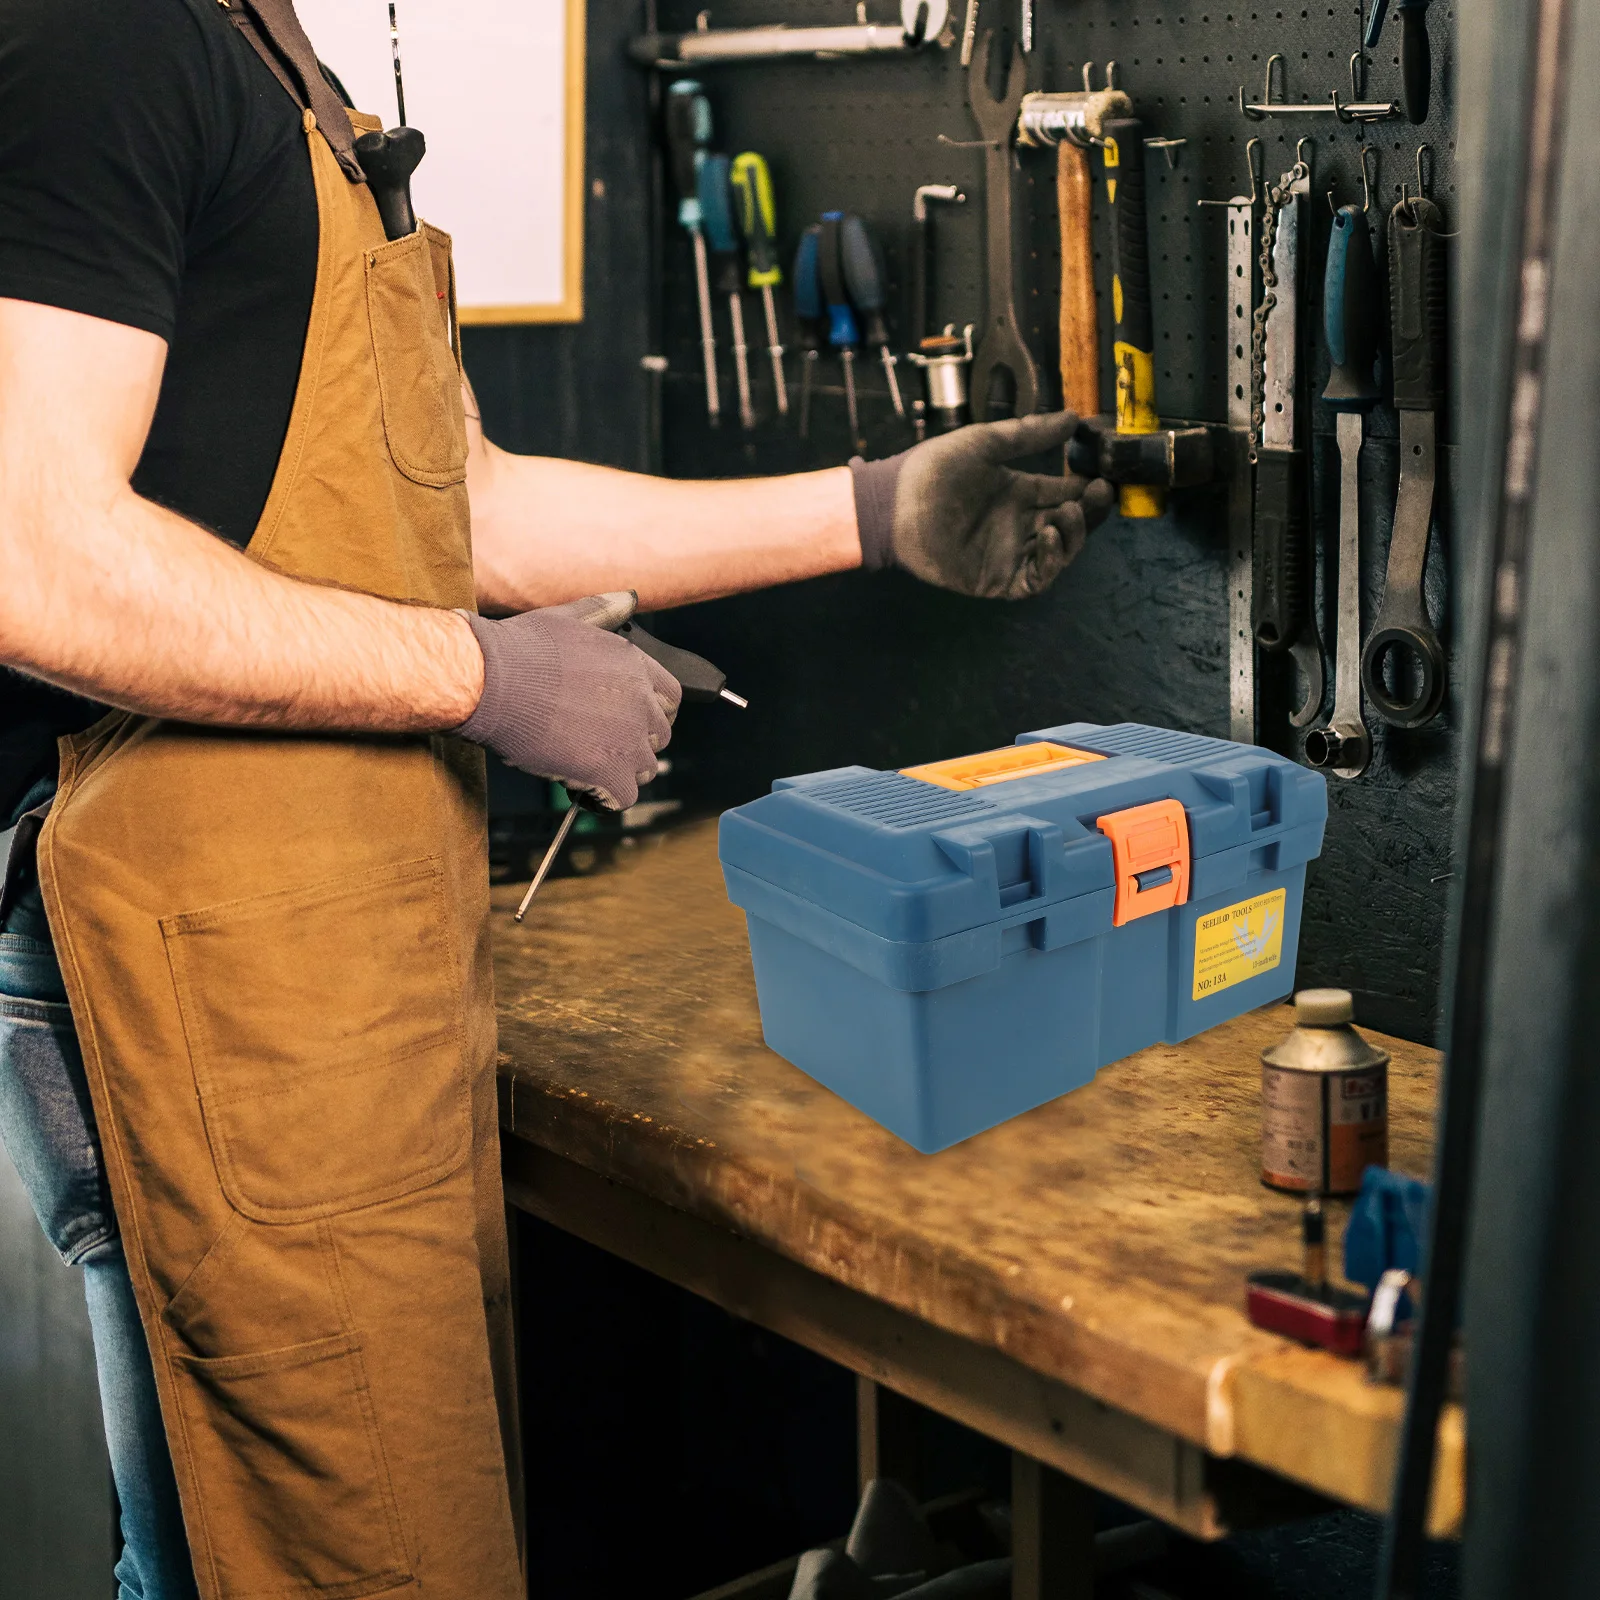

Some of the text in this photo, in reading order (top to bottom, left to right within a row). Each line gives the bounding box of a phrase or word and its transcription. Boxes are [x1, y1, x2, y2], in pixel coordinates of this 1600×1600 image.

[1232, 905, 1252, 919] TOOLS
[1197, 972, 1227, 992] NO: 13A
